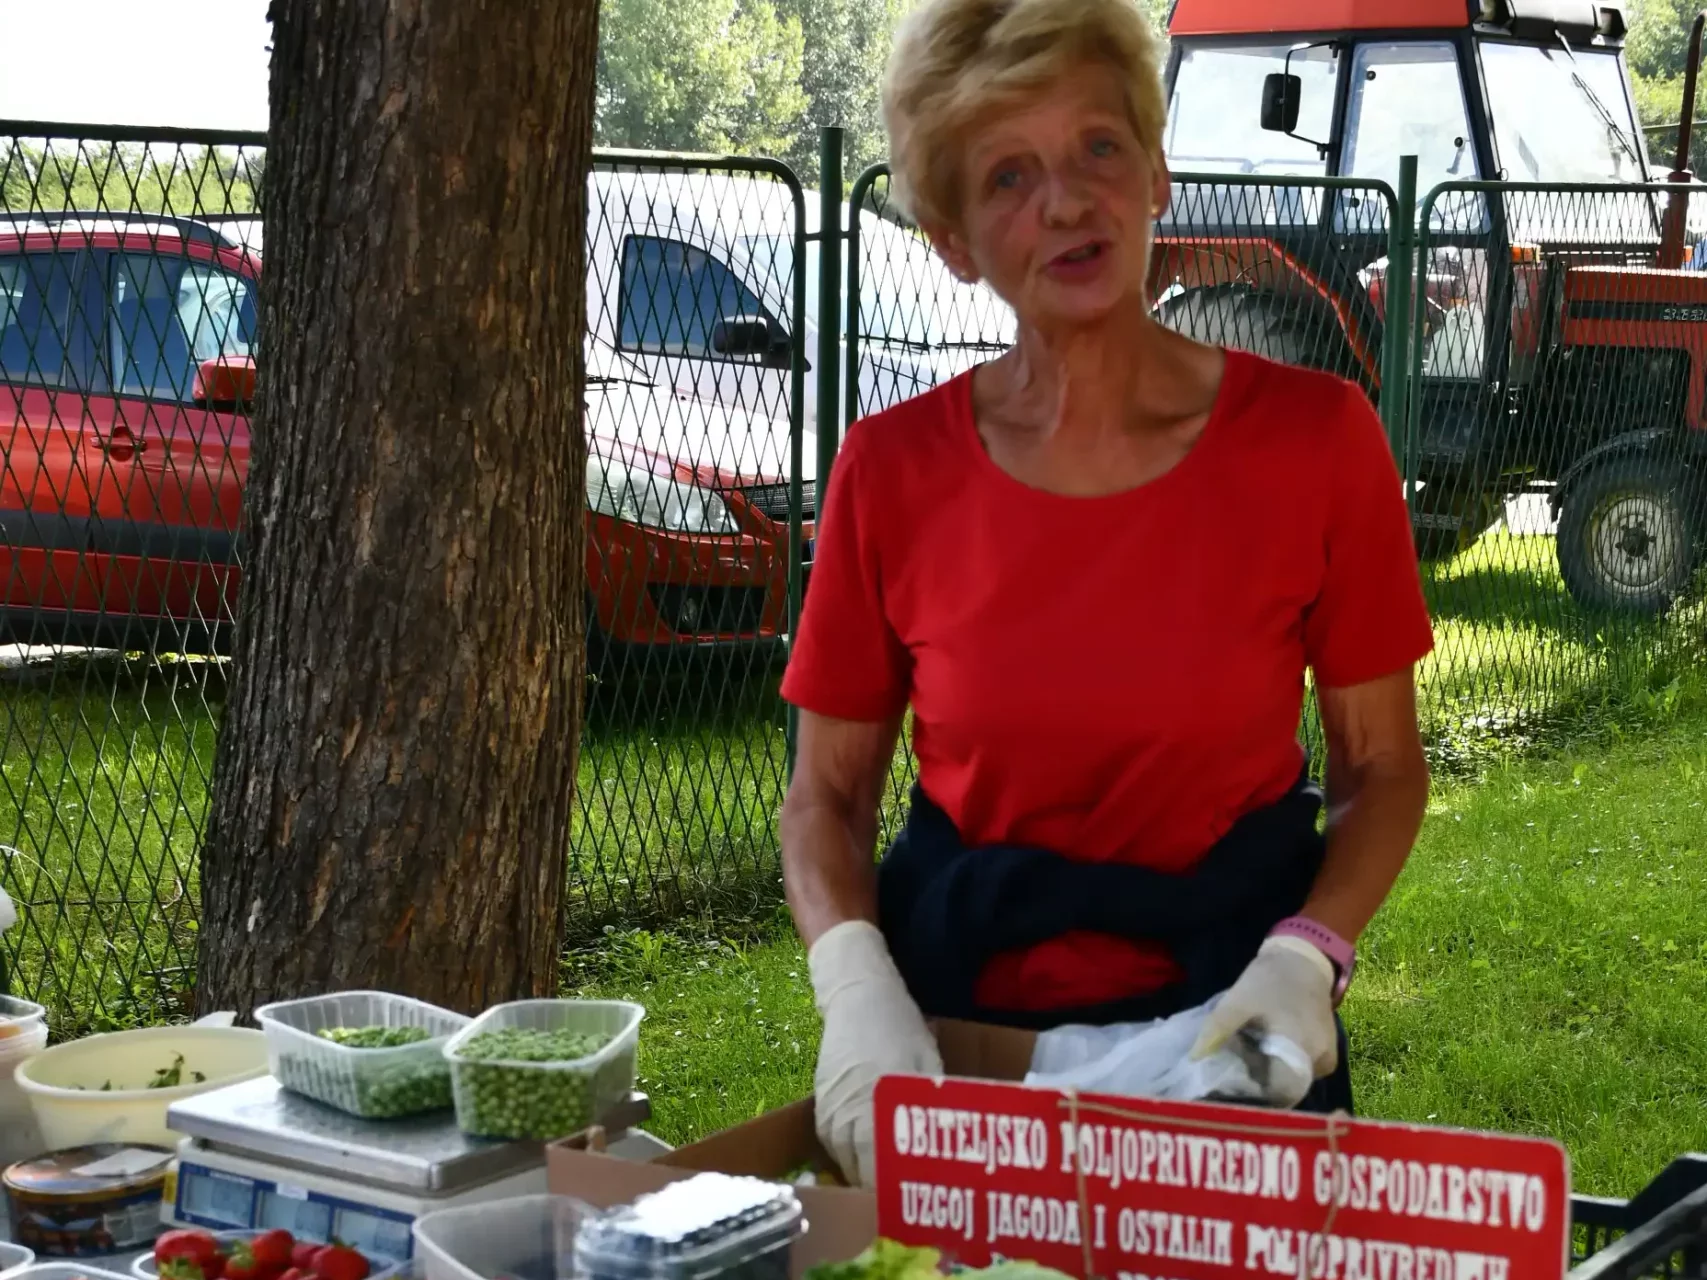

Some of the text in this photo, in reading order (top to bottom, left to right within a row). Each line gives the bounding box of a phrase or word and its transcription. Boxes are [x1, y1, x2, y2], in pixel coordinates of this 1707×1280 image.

[894, 1104, 1545, 1232] OBITELJSKO POLJOPRIVREDNO GOSPODARSTVO
[900, 1181, 975, 1241] UZGOJ
[986, 1191, 1081, 1247] JAGODA
[1093, 1204, 1107, 1249] I
[1118, 1207, 1233, 1266] OSTALIH
